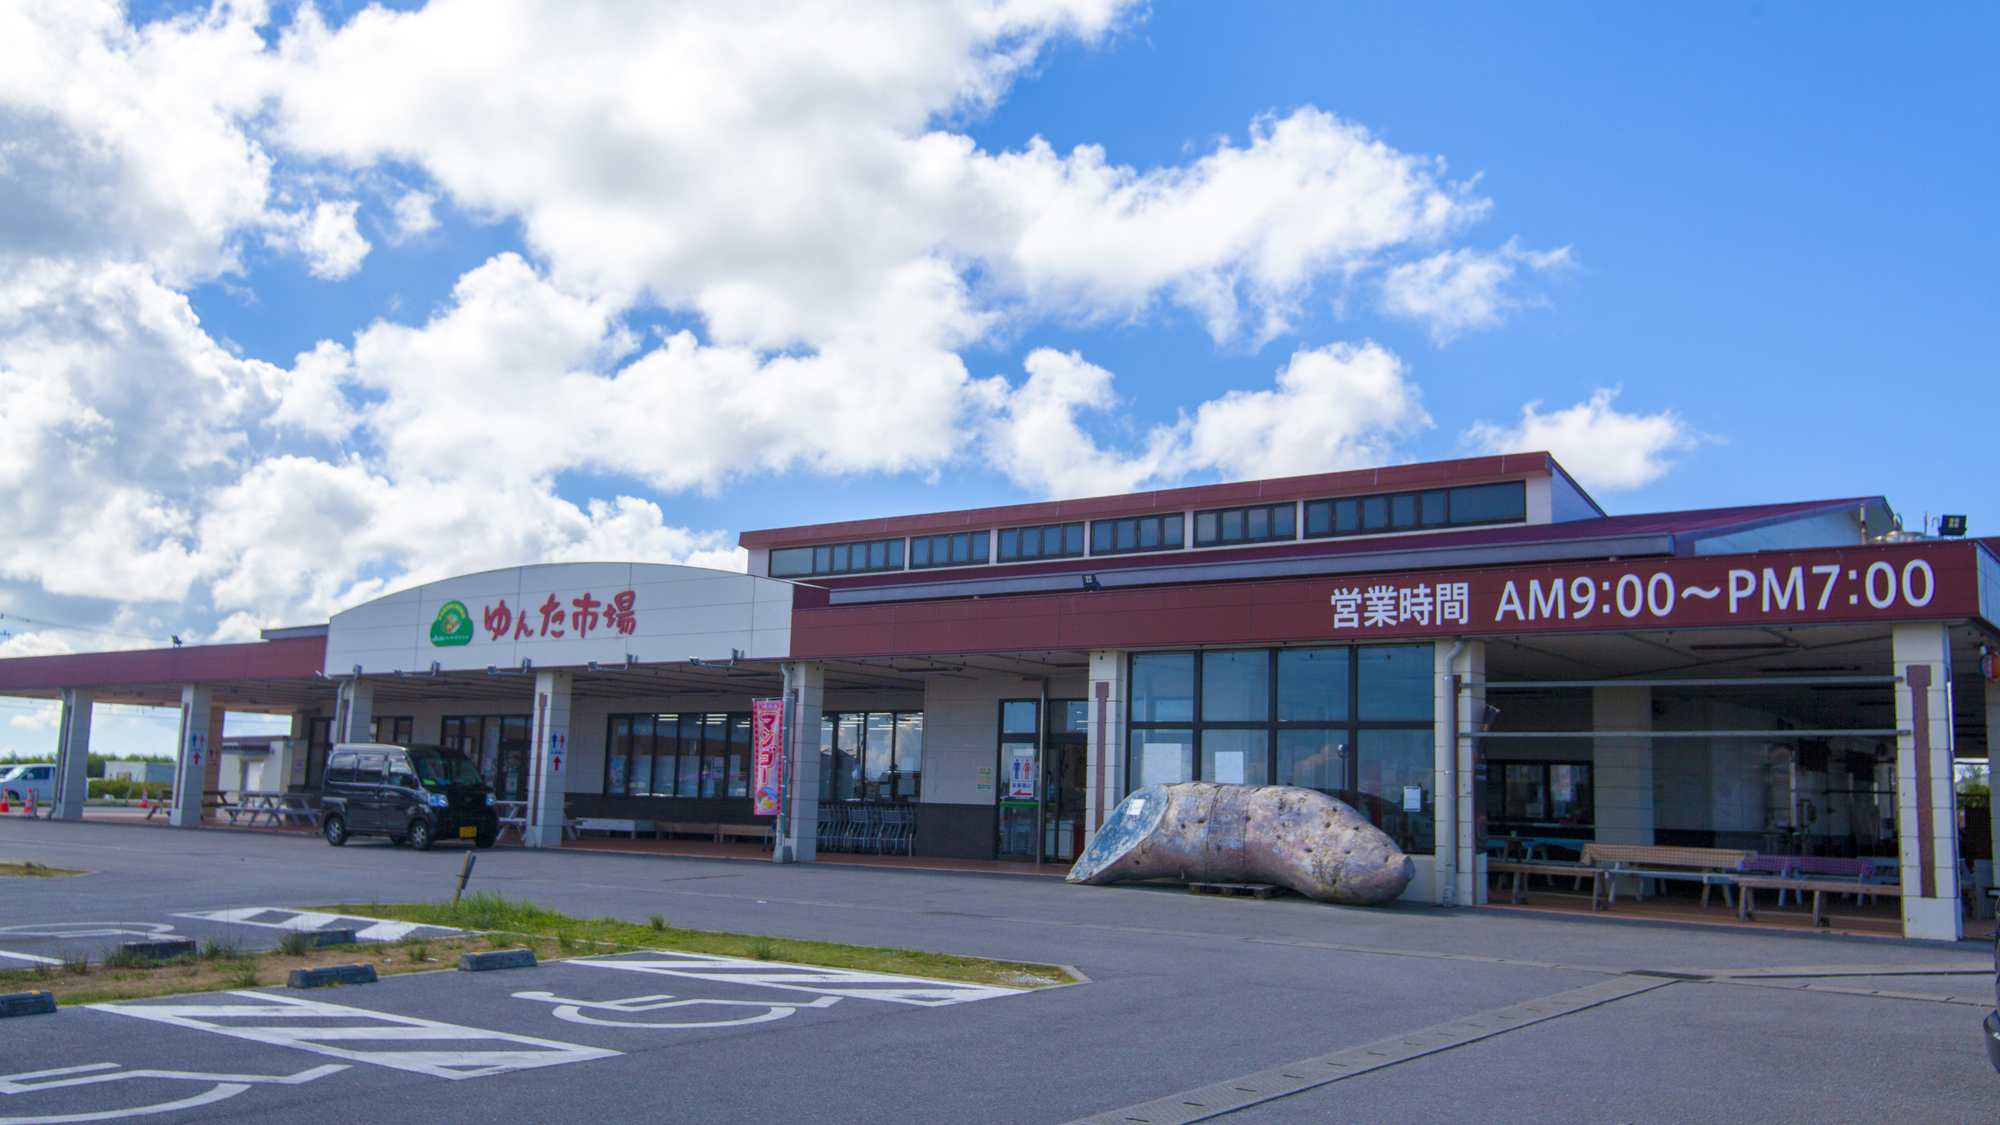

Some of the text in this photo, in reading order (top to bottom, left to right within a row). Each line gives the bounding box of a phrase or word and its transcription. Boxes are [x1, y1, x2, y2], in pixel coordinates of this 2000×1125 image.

[484, 590, 636, 641] ゆんた市場
[1330, 582, 1469, 629] 営業時間
[760, 712, 777, 785] マンゴー
